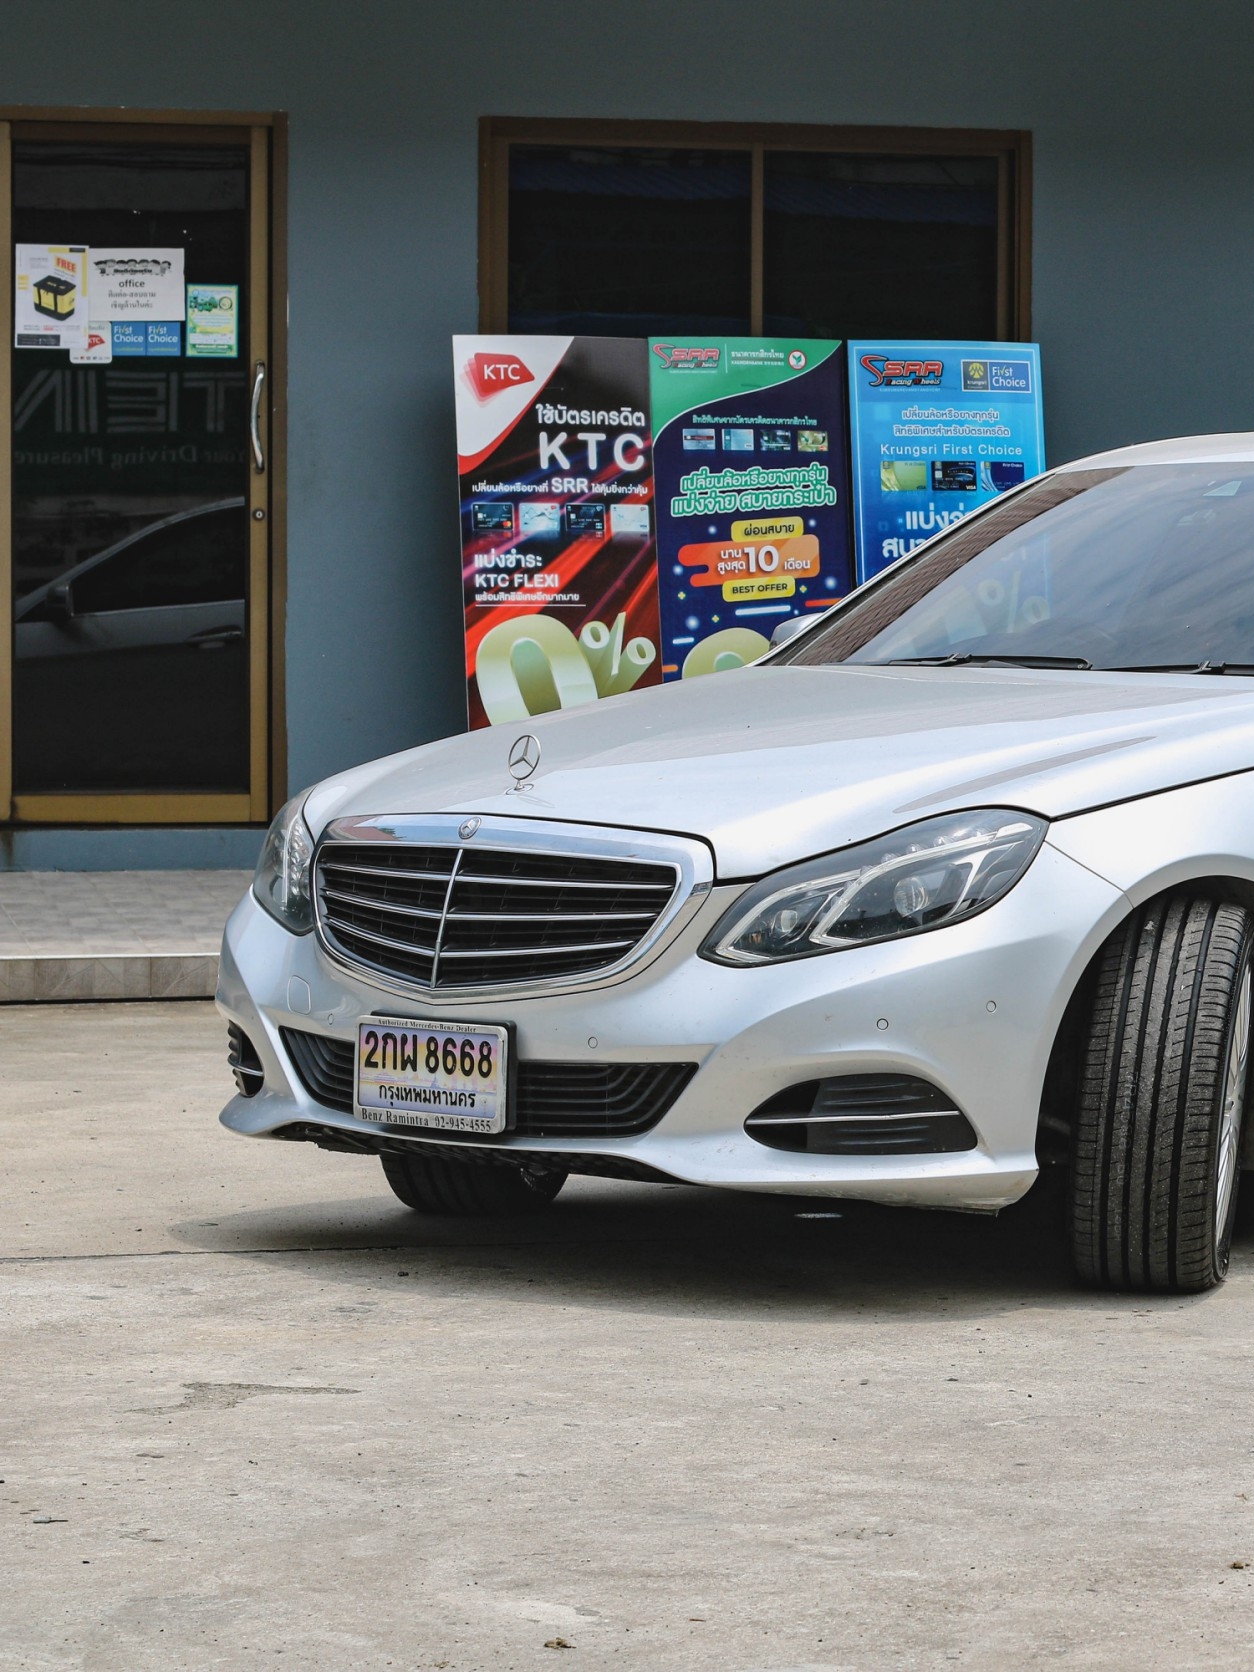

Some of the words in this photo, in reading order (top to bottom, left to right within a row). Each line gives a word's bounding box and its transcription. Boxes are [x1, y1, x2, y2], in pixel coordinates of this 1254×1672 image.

[56, 256, 76, 273] FREE
[119, 279, 145, 288] office
[113, 334, 144, 343] Choice
[148, 334, 178, 343] Choice
[483, 364, 521, 380] KTC
[992, 377, 1026, 387] Choice
[535, 403, 645, 426] ใช้บัตรเครดิต
[902, 406, 999, 423] เปลี่ยนล้อหรือยางทุกรุ่น
[893, 424, 1010, 437] สิทธิพิเศษสำหรับบัตรเครดิต
[539, 431, 645, 471] KTC
[881, 444, 937, 458] Krungsri
[943, 444, 972, 455] First
[978, 444, 1023, 456] Choice
[472, 479, 549, 493] เปลี่ยนล้อหรือยางที่
[551, 477, 589, 493] SRR
[682, 463, 826, 491] เปลี่ยนล้อหรือยางทุกรุ่น
[673, 490, 736, 514] แบ่งจ่าย
[740, 484, 834, 509] สบายกระเป๋า
[744, 523, 795, 536] ผ่อนสบาย
[474, 548, 542, 568] แบ่งชำระ
[720, 549, 742, 559] นาน
[744, 545, 779, 573] 10
[784, 557, 811, 571] เดือน
[717, 560, 745, 575] สูงสุด
[475, 574, 509, 588] KTC
[514, 573, 559, 588] FLEXI
[732, 585, 755, 595] BEST
[757, 583, 788, 593] OFFER
[378, 1018, 408, 1027] Authorized
[410, 1021, 454, 1031] Mercedes-Benz
[455, 1025, 477, 1033] Dealer
[425, 1036, 492, 1078] 8668
[379, 1084, 476, 1108] กรุงเทพมหานคร
[361, 1108, 383, 1122] Benz
[386, 1110, 429, 1127] Ramintra
[435, 1115, 491, 1132] 02-945-4555
